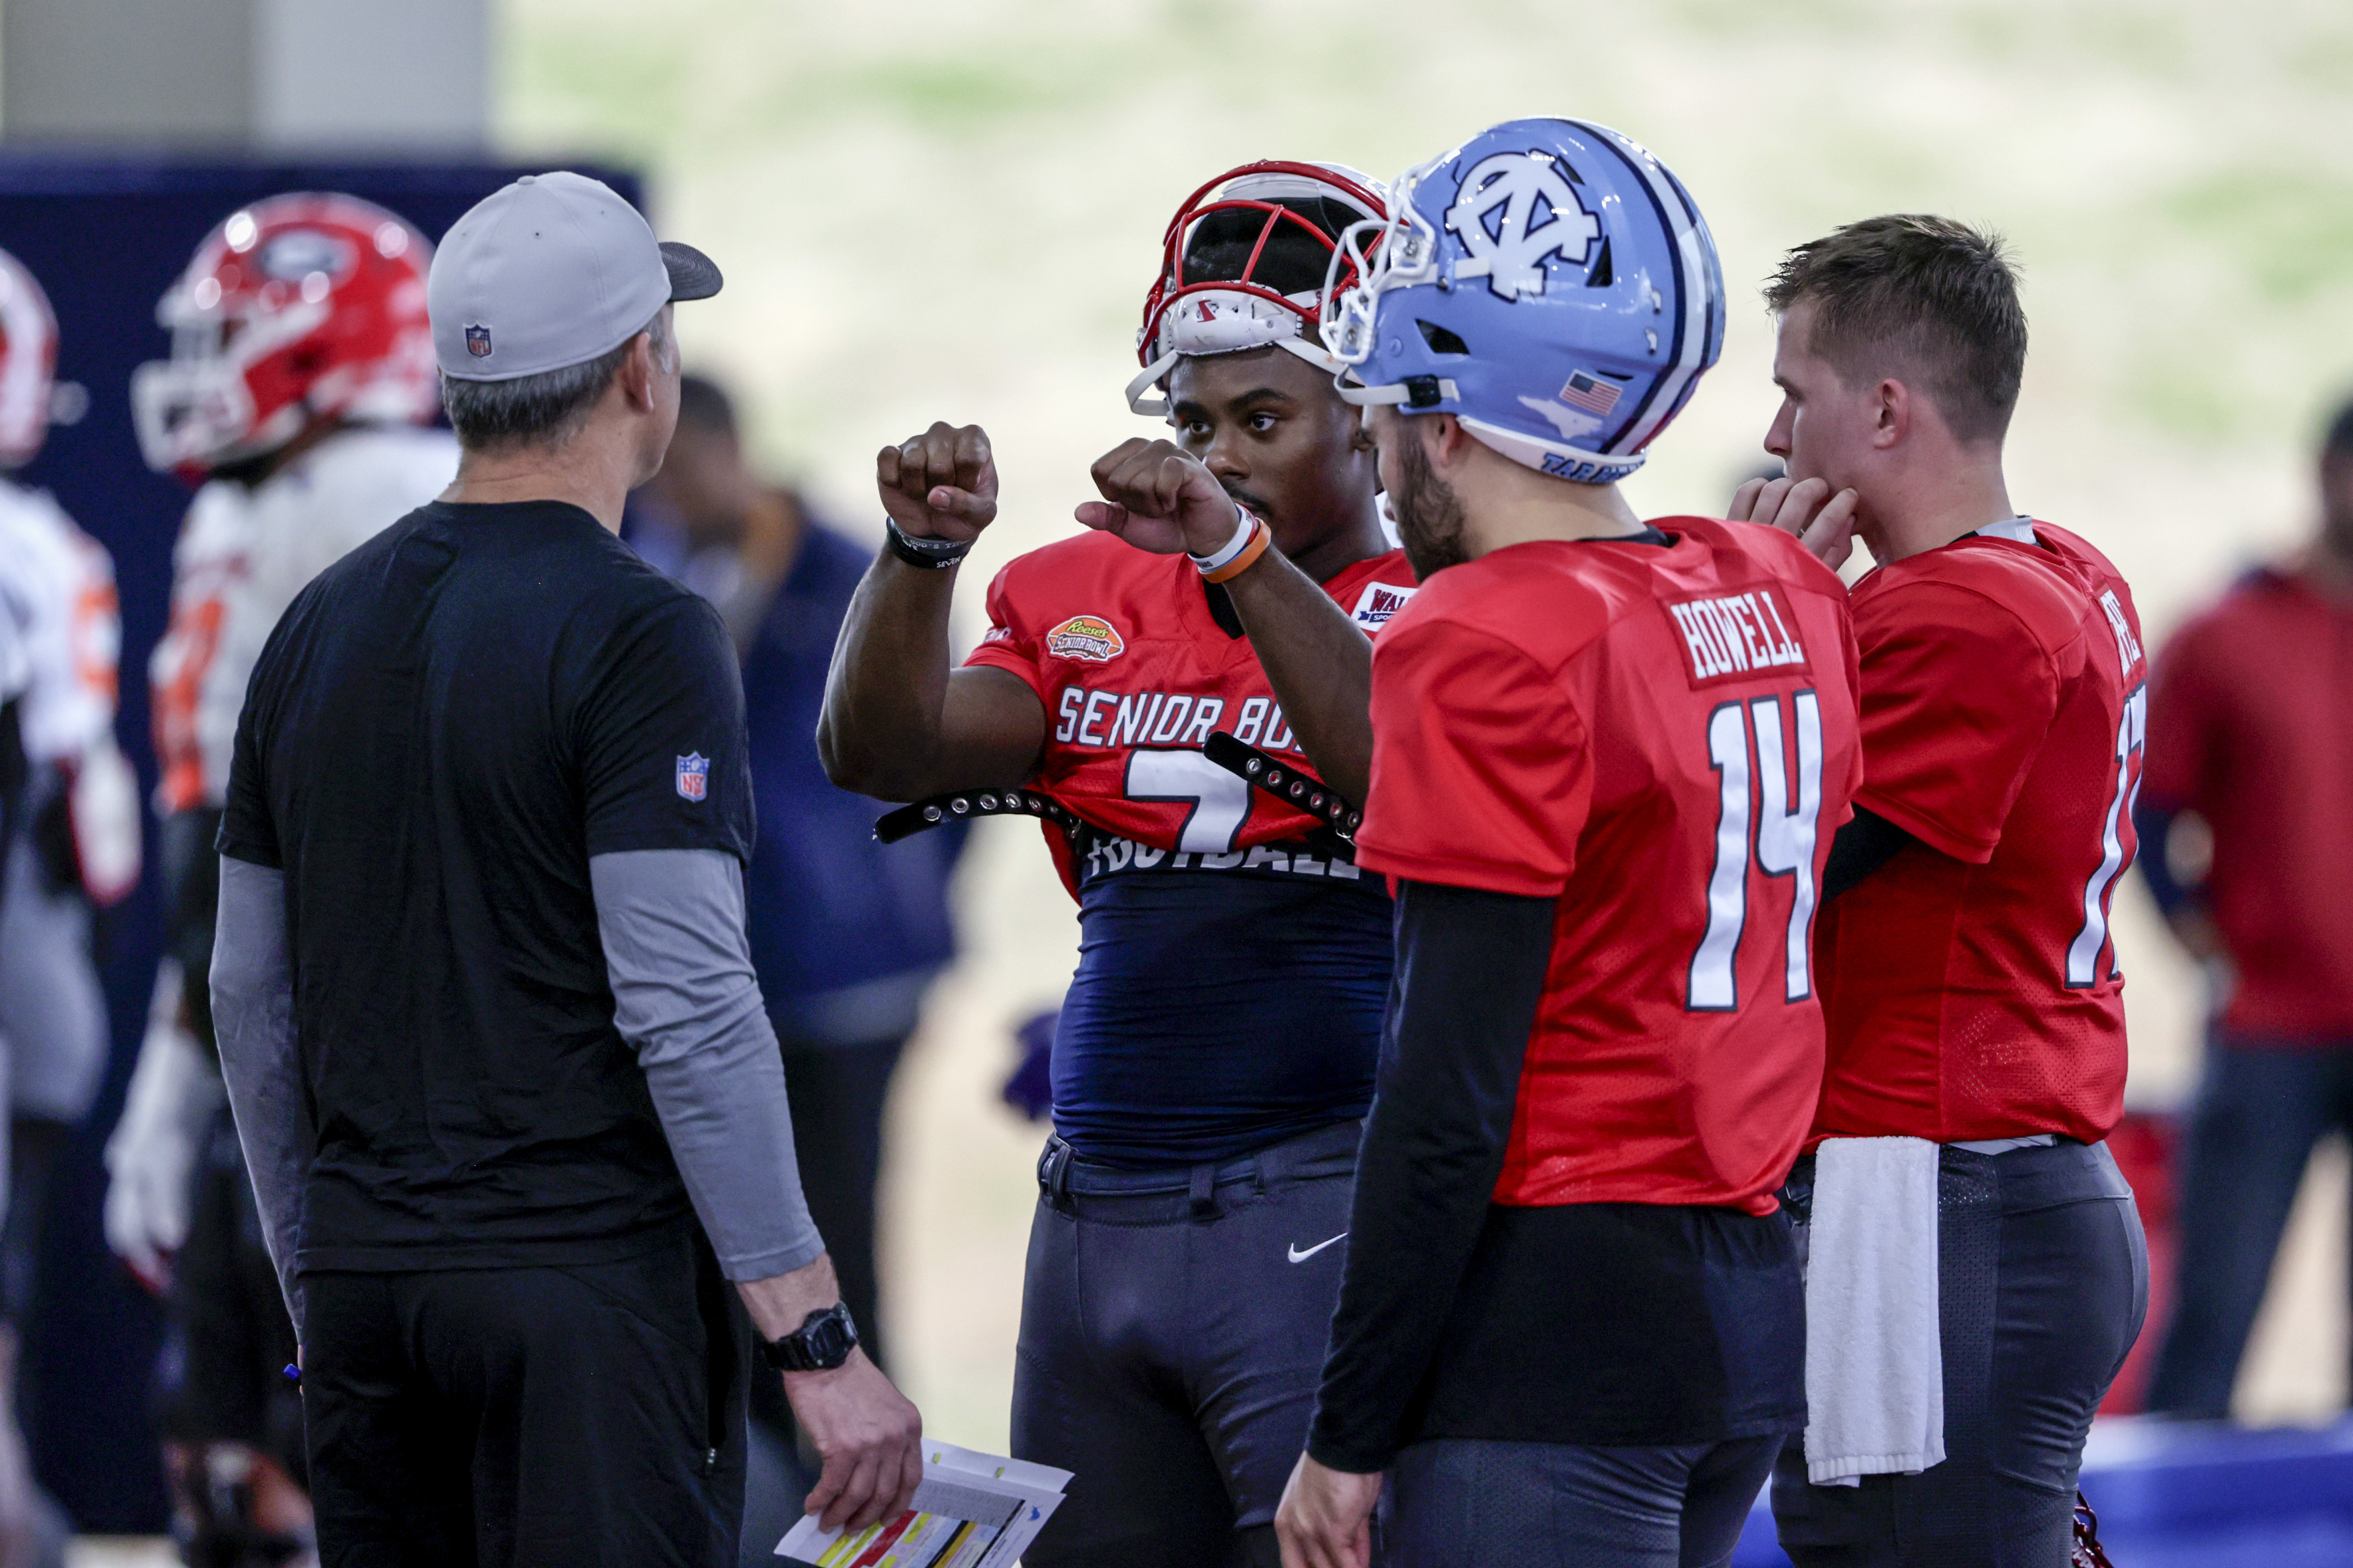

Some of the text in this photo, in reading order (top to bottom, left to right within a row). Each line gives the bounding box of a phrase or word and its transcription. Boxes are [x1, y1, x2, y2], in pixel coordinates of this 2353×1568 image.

[470, 339, 489, 355] NFL
[1542, 452, 1595, 482] TAR
[936, 556, 961, 568] SEVEN
[1055, 635, 1085, 650] SENIOR
[1084, 638, 1108, 657] BOWL
[1670, 591, 1804, 679] HOWELL
[1055, 684, 1303, 753] SENIOR BO
[682, 774, 705, 795] NFL
[1123, 747, 1254, 853] 7
[1684, 688, 1824, 1012] 14
